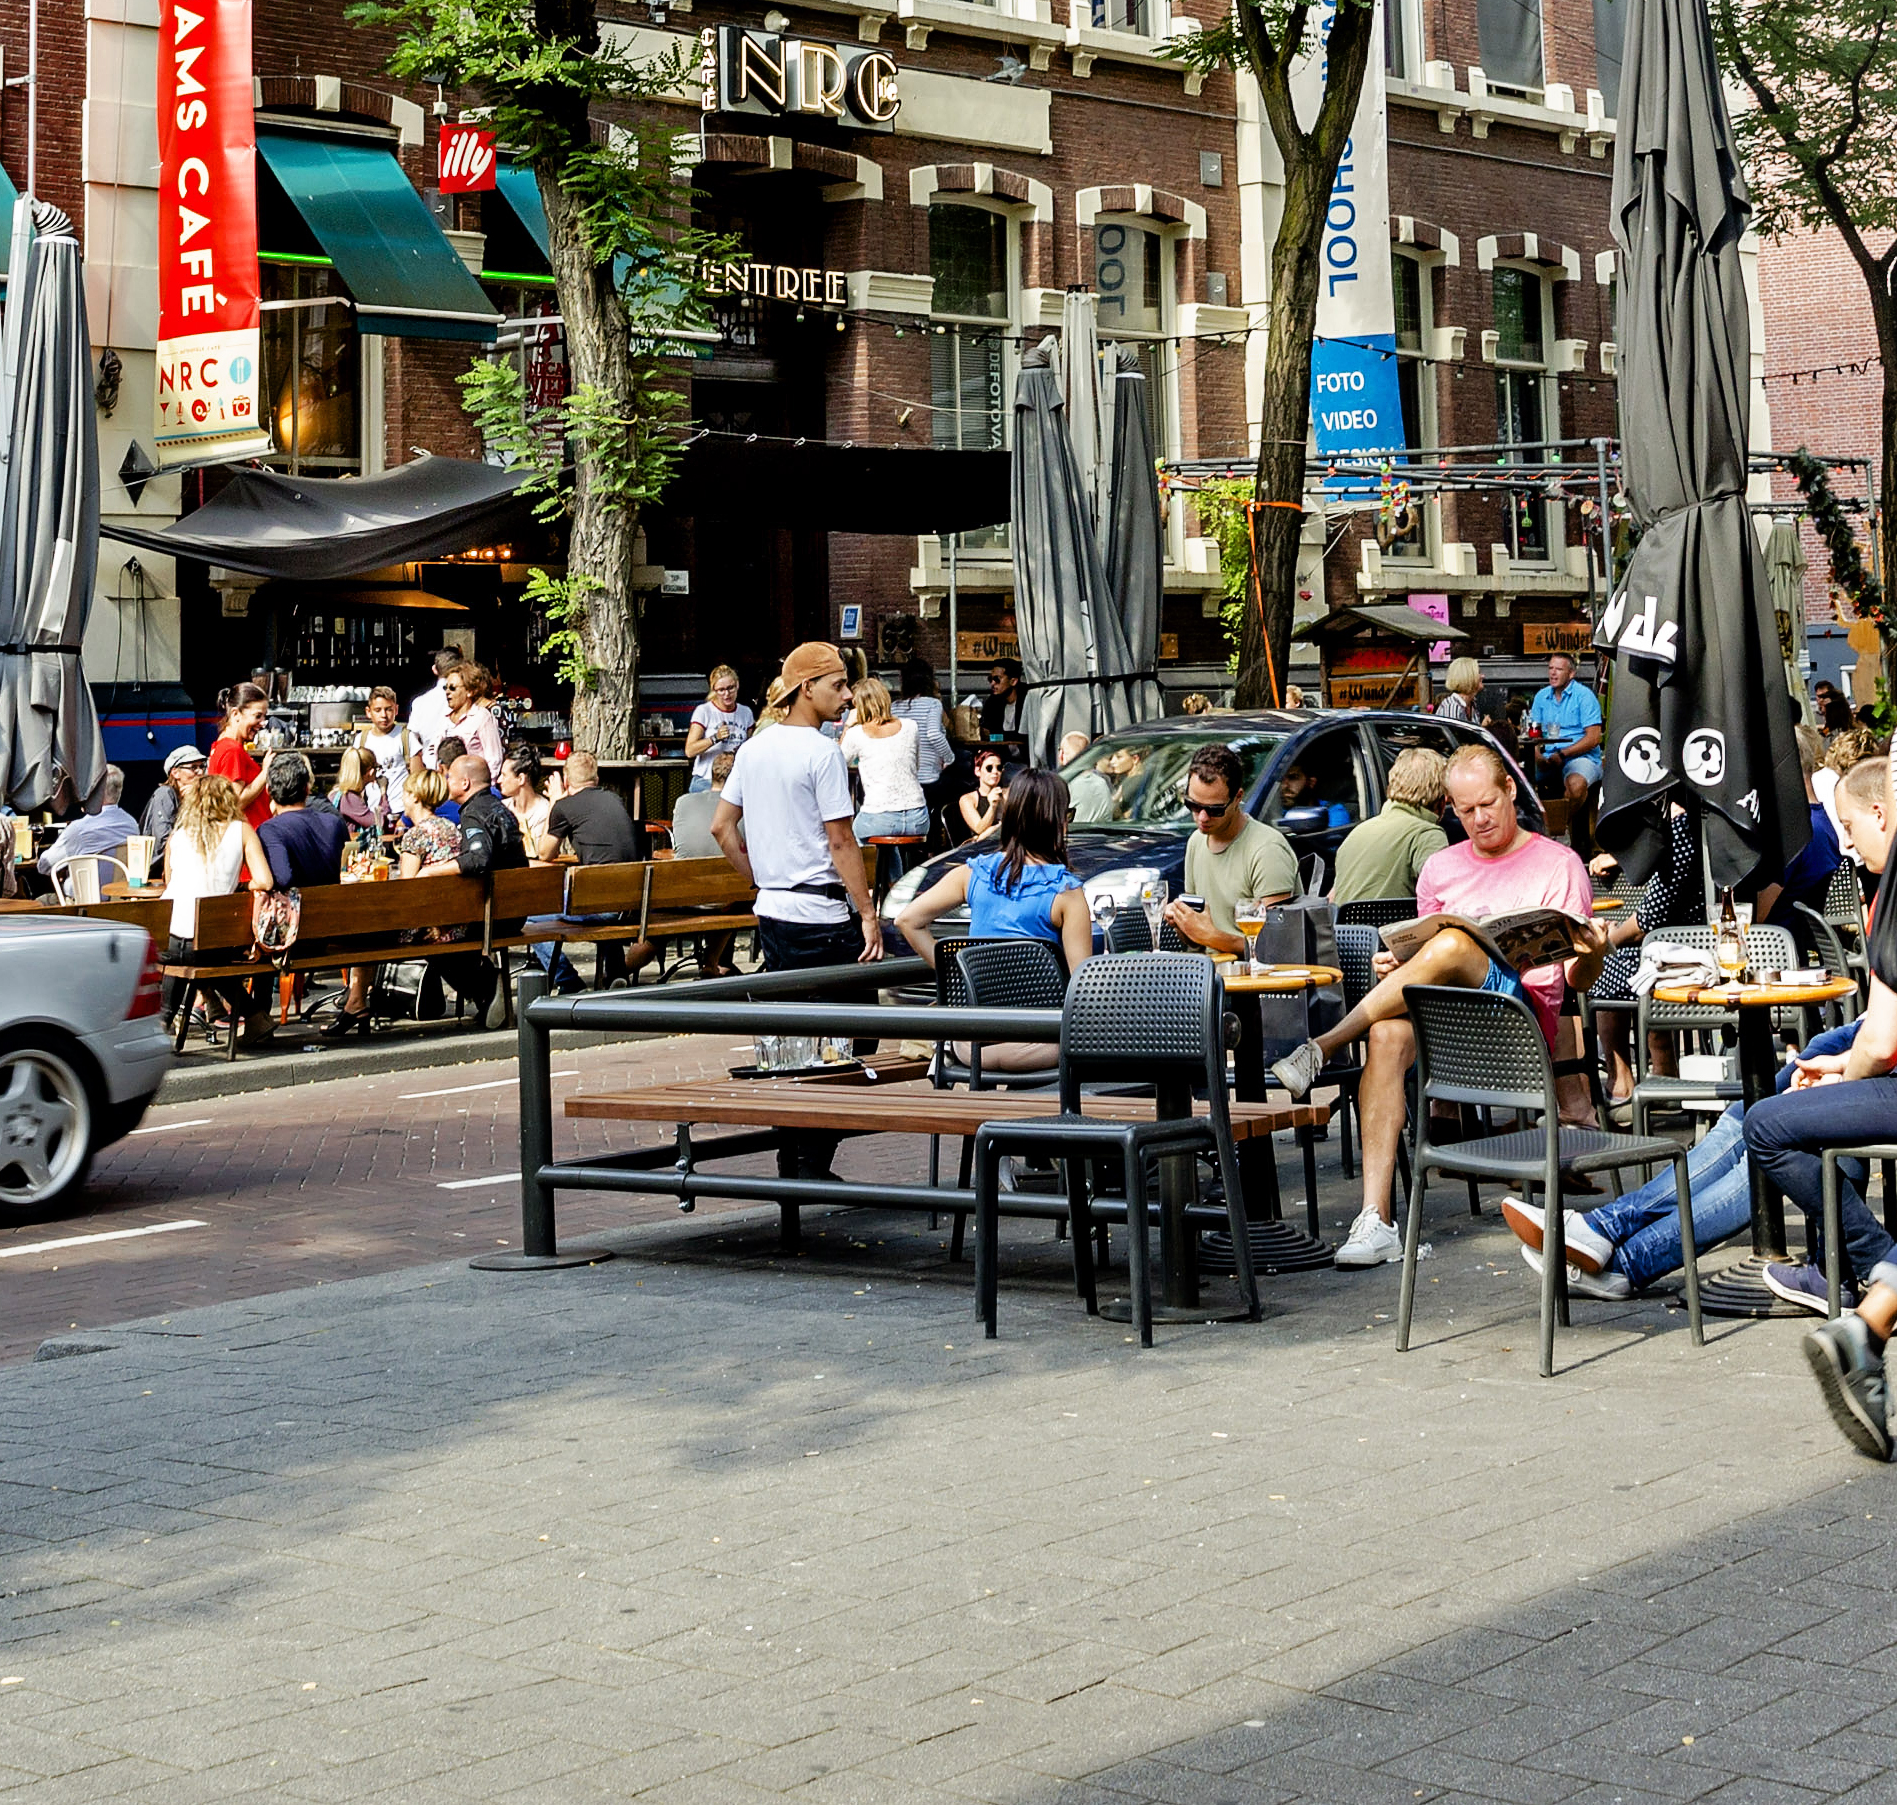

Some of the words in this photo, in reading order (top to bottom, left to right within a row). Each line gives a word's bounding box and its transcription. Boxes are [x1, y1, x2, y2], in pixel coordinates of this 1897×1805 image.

[442, 131, 493, 187] illy
[177, 157, 229, 317] CAFÉ
[703, 258, 846, 304] ENTREE
[159, 358, 219, 395] NRC
[1316, 371, 1365, 393] FOTO
[1321, 409, 1378, 431] VIDEO
